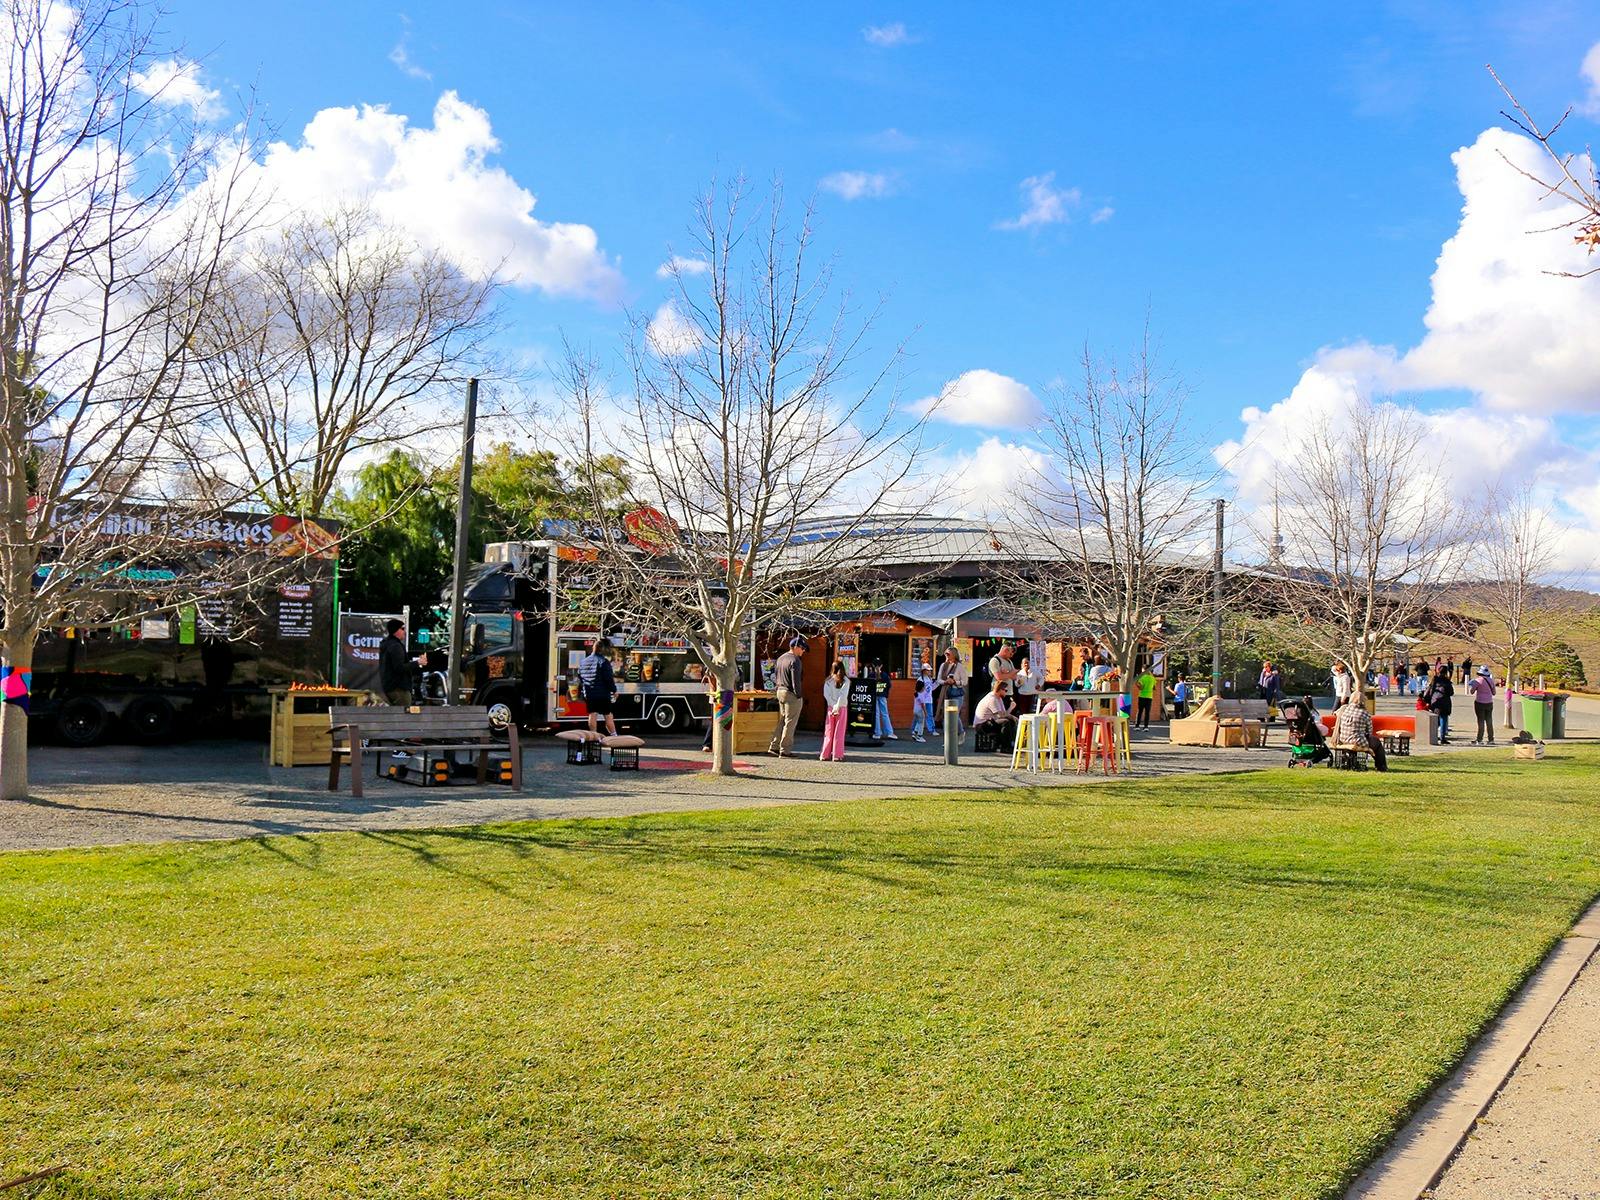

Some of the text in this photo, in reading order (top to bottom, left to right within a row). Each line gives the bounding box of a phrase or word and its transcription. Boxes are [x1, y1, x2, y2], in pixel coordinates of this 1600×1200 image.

[348, 633, 382, 647] Germ
[352, 648, 380, 660] Sausa
[855, 685, 868, 693] HOT
[851, 693, 872, 703] CHIPS
